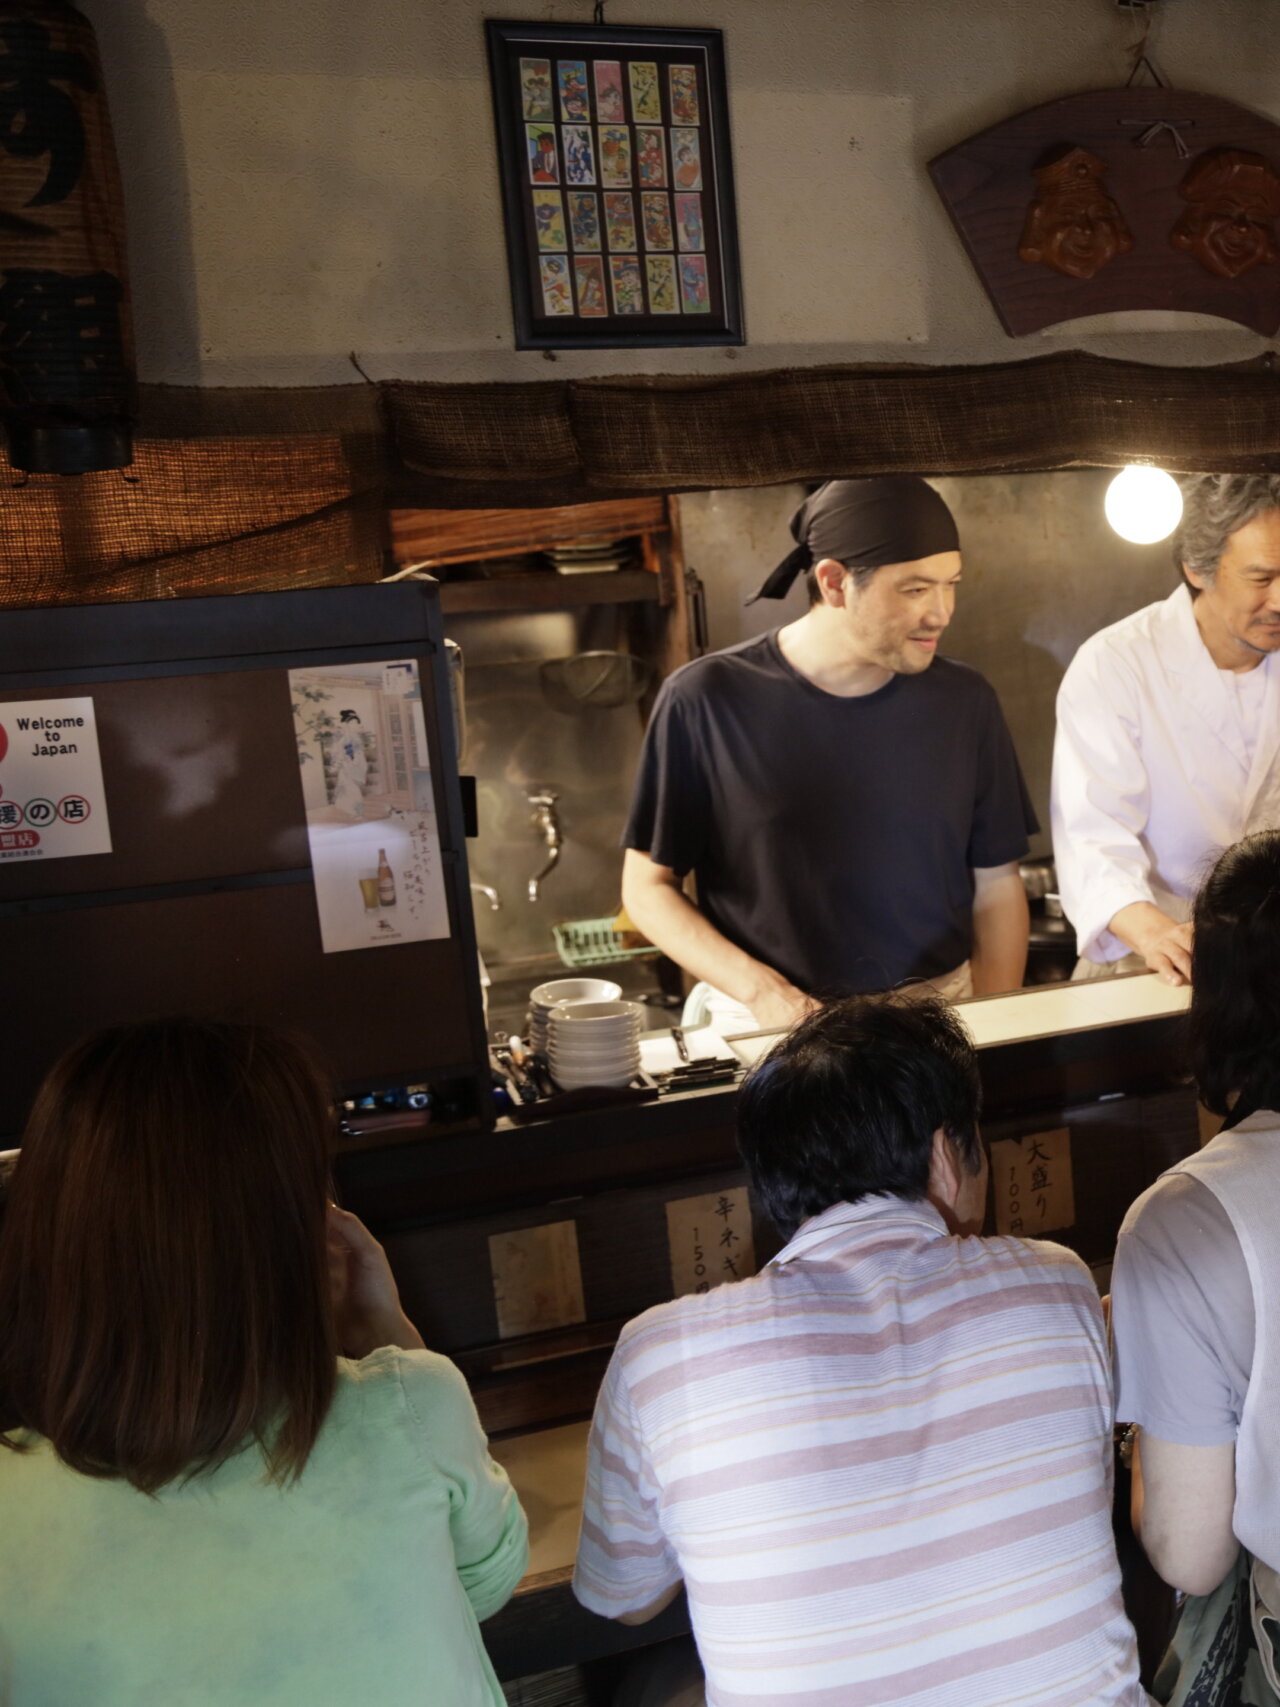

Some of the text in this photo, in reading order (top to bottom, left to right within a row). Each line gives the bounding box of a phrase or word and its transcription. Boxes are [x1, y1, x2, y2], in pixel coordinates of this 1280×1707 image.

[16, 716, 85, 731] Welcome
[44, 731, 62, 742] to
[31, 743, 78, 758] Japan
[1026, 1139, 1053, 1219] 大盛り
[1008, 1165, 1024, 1233] 100円
